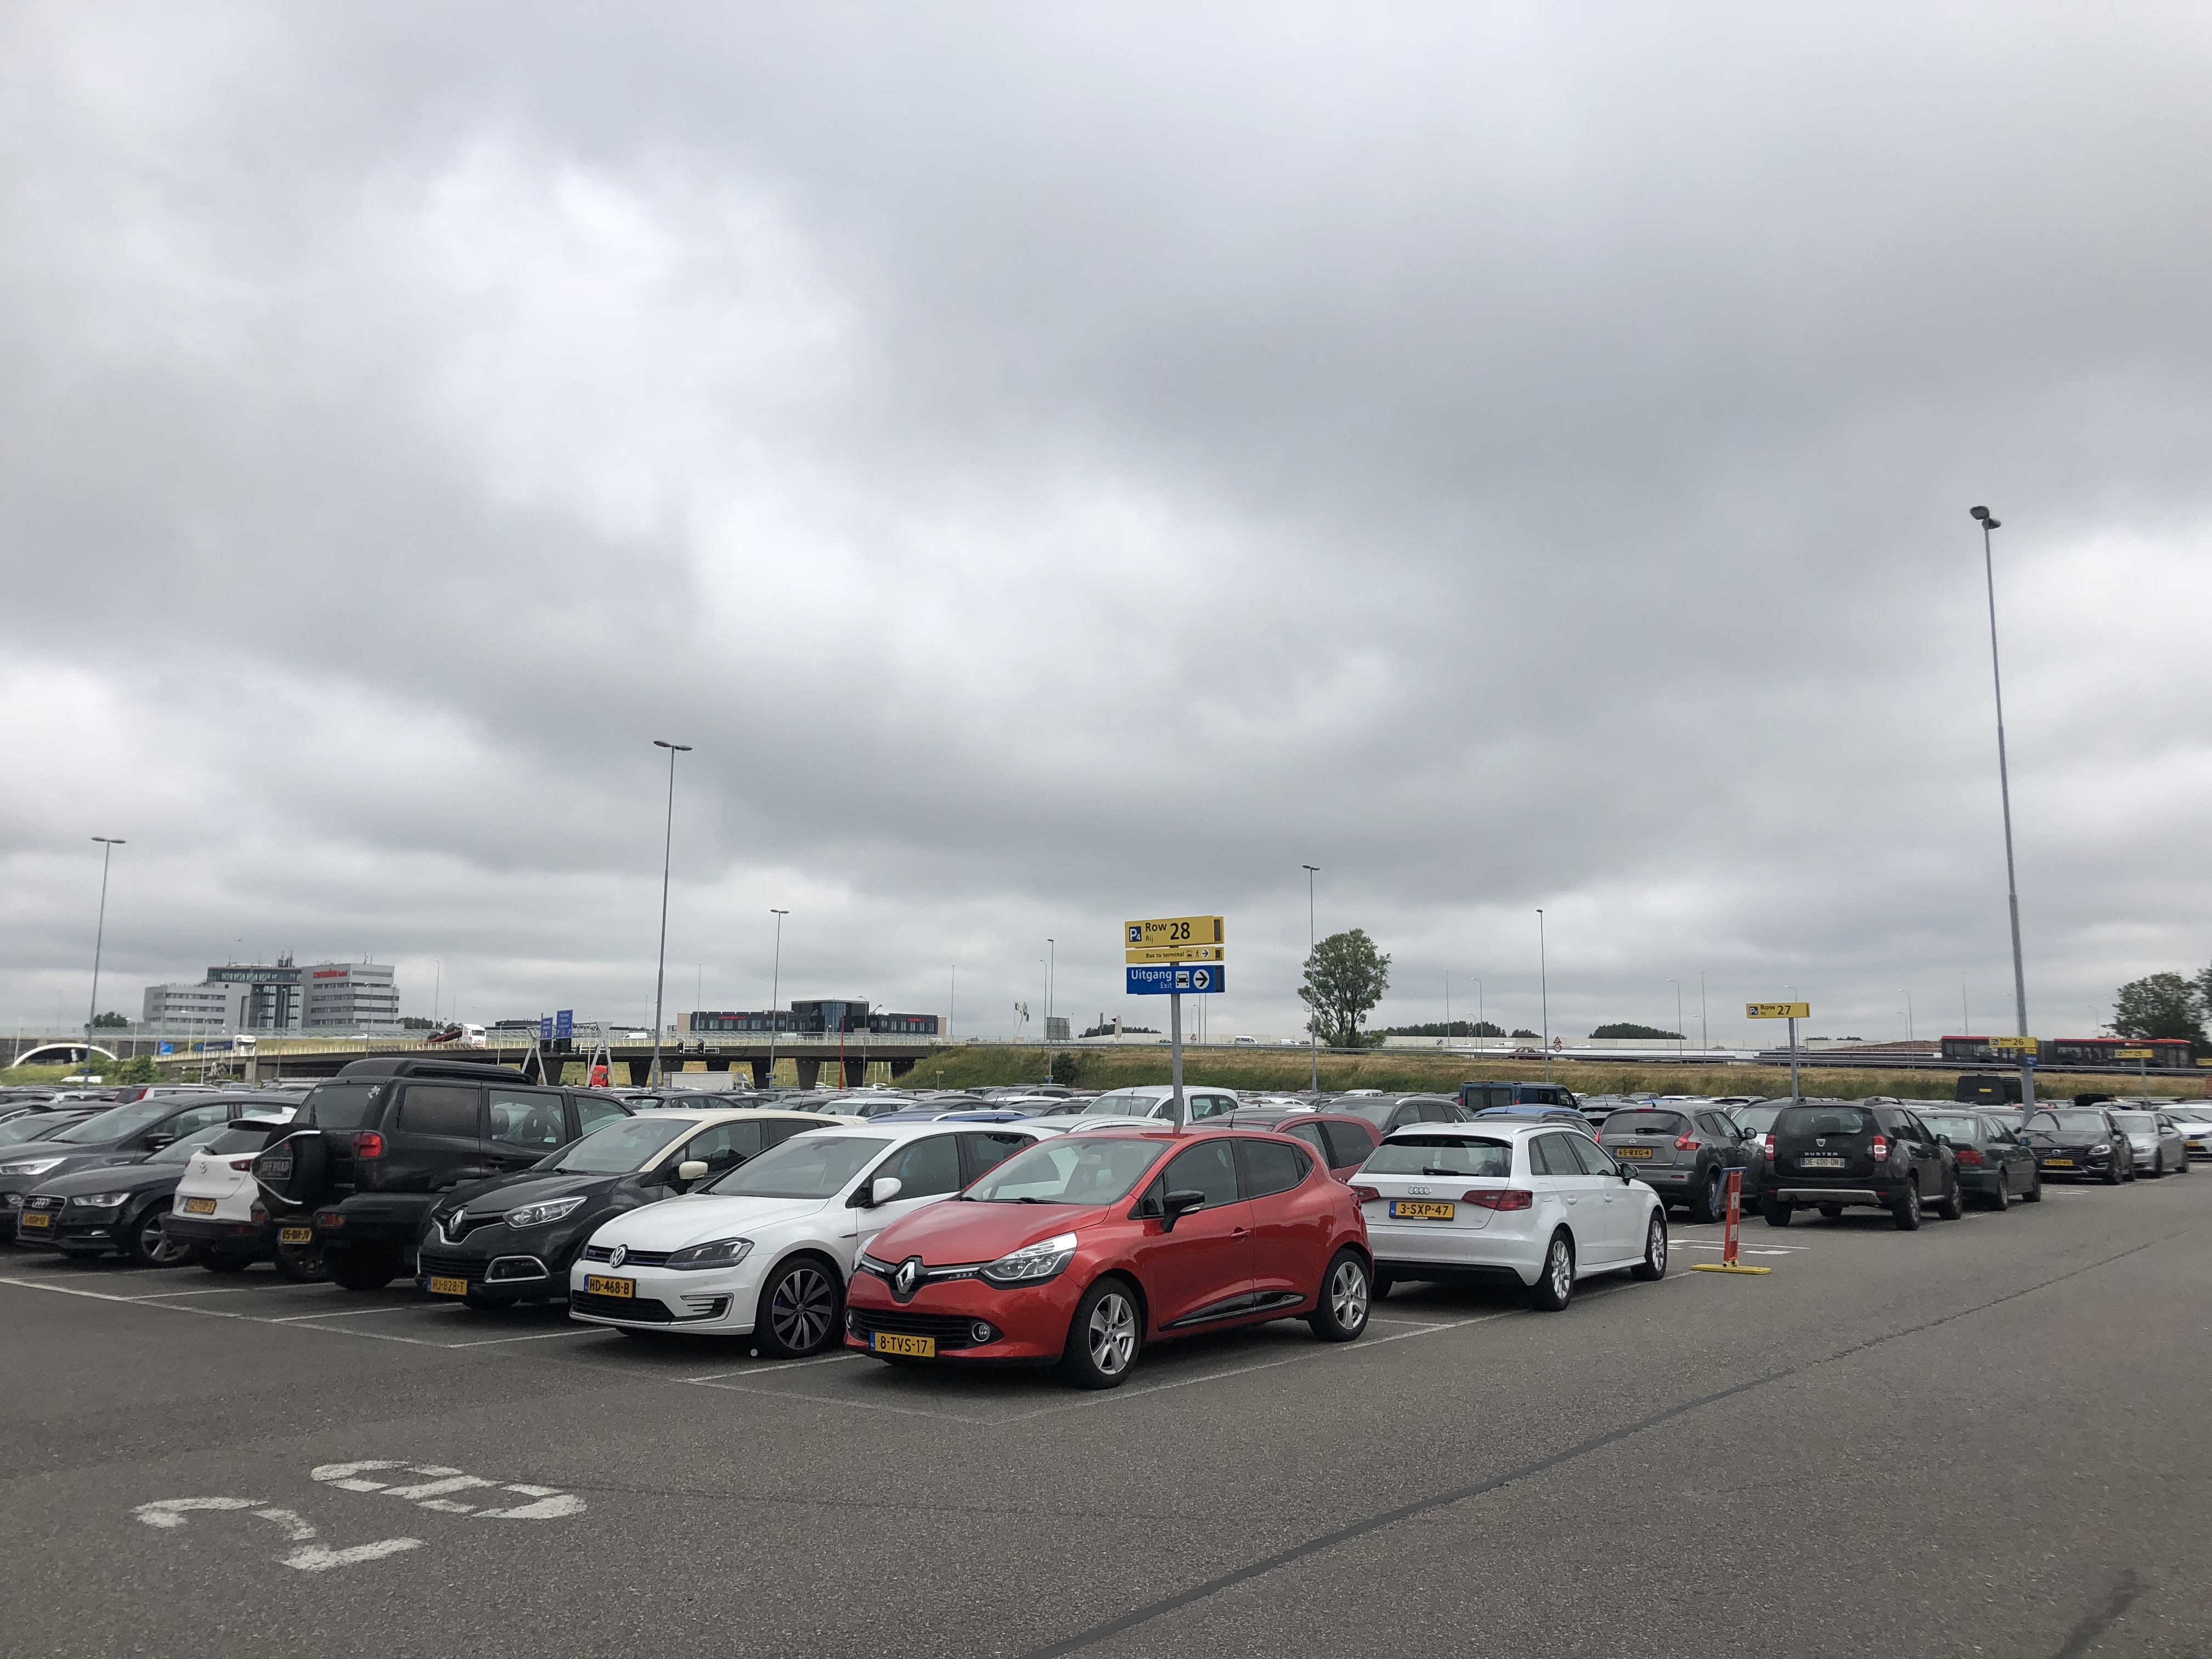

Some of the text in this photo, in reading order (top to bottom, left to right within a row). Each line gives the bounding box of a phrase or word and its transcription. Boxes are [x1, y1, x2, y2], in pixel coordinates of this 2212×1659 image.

[1146, 922, 1190, 940] Row 28
[1131, 969, 1172, 982] Uitgang
[1778, 1005, 1791, 1015] 27
[1400, 1204, 1448, 1216] 3-SXP-47
[433, 1280, 465, 1293] HJ-828-T
[590, 1278, 629, 1295] HD-468-B
[881, 1336, 928, 1353] 8-TVS-17
